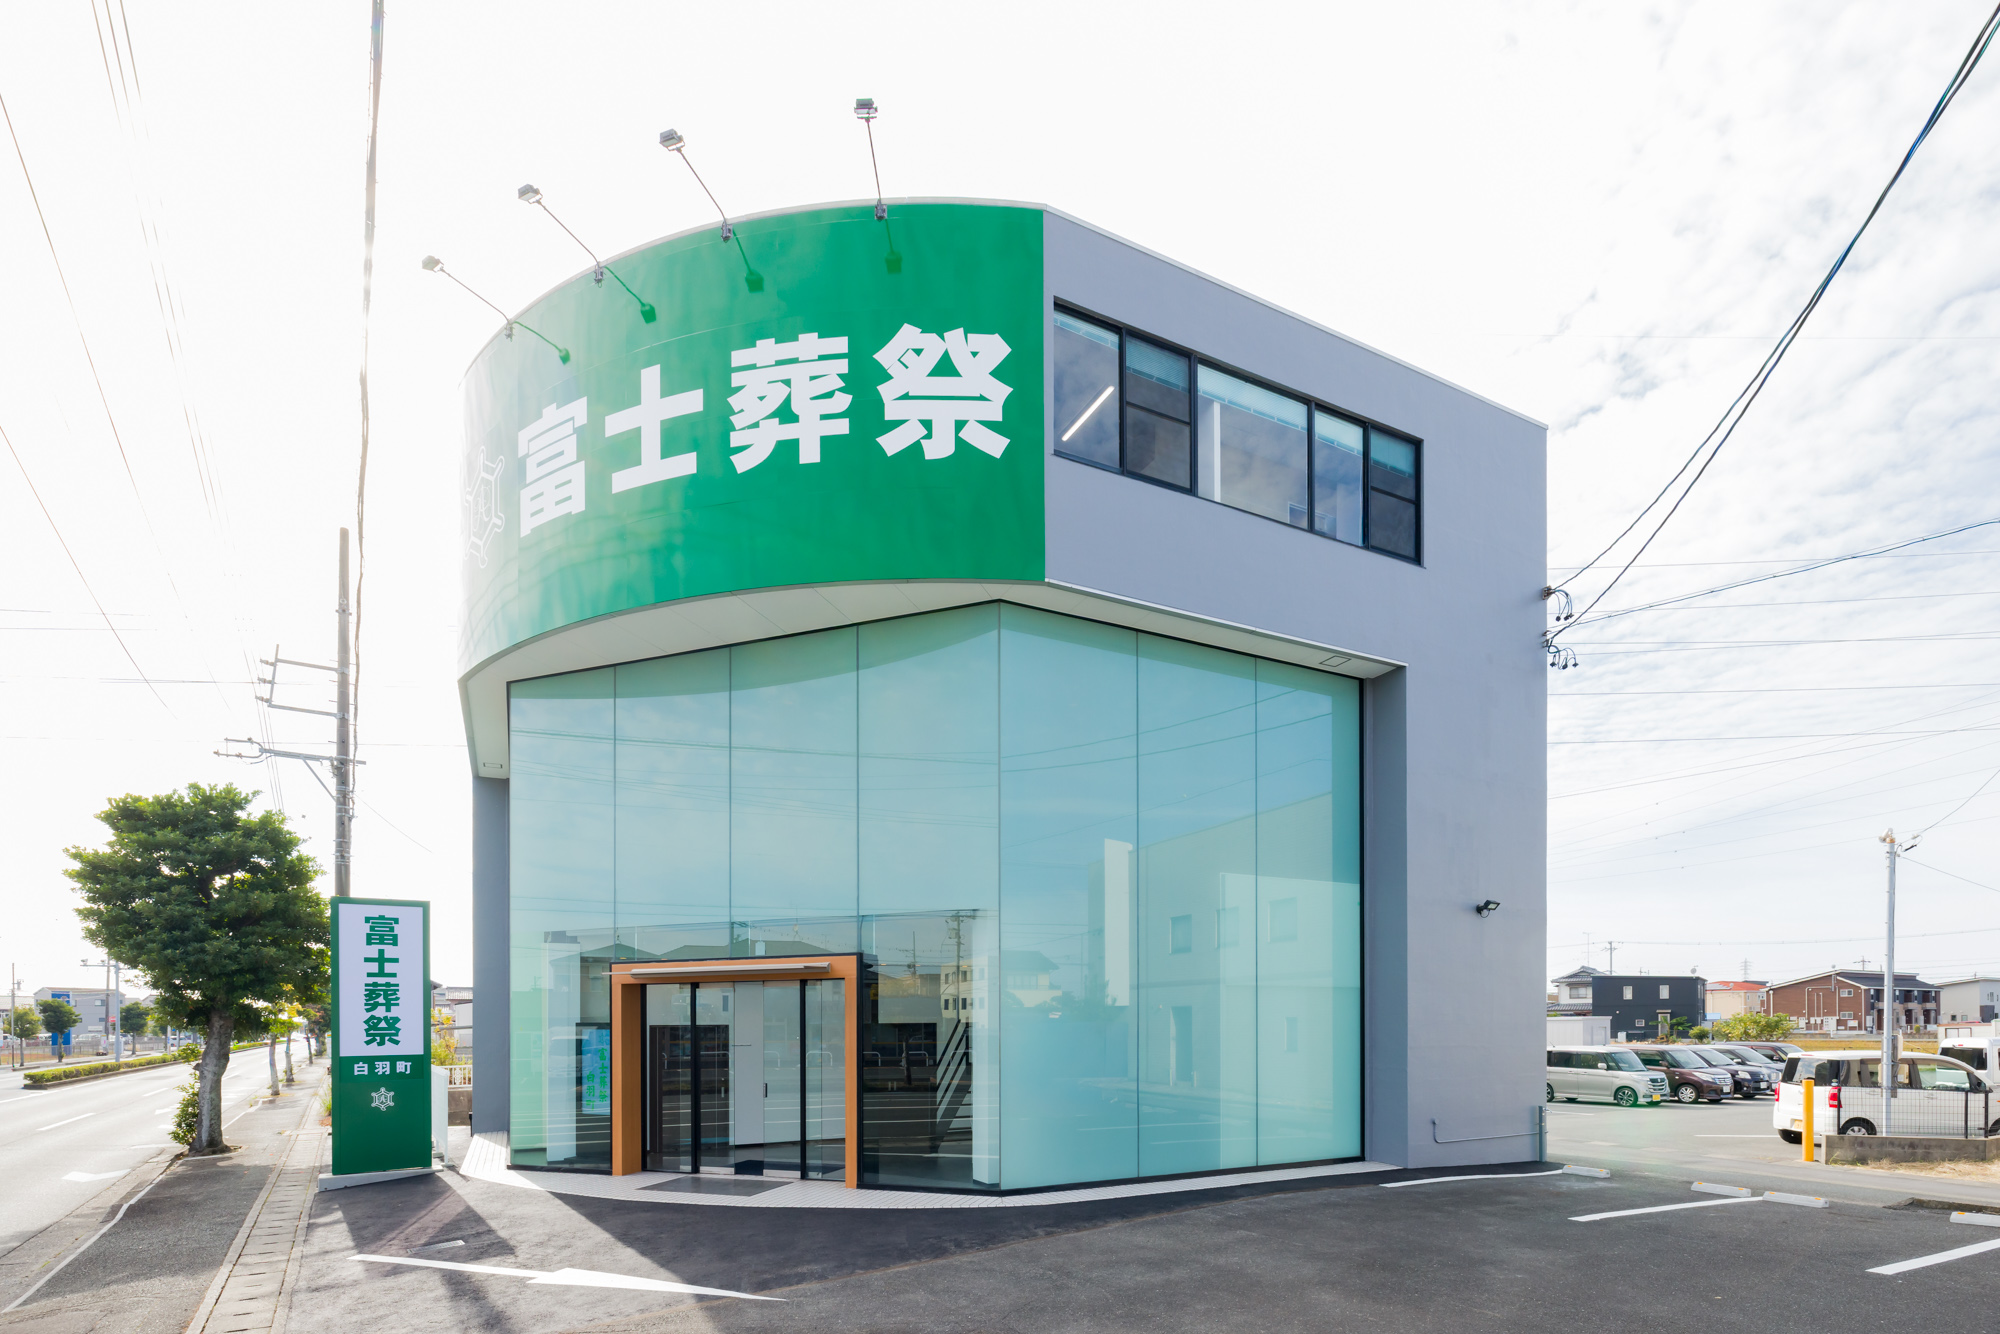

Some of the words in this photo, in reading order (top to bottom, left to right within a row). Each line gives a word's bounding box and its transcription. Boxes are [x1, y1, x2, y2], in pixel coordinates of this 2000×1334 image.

[517, 323, 1013, 537] 富士葬祭
[363, 915, 401, 1046] 富士葬祭
[354, 1061, 412, 1075] 白羽町
[585, 1071, 595, 1111] 白羽町
